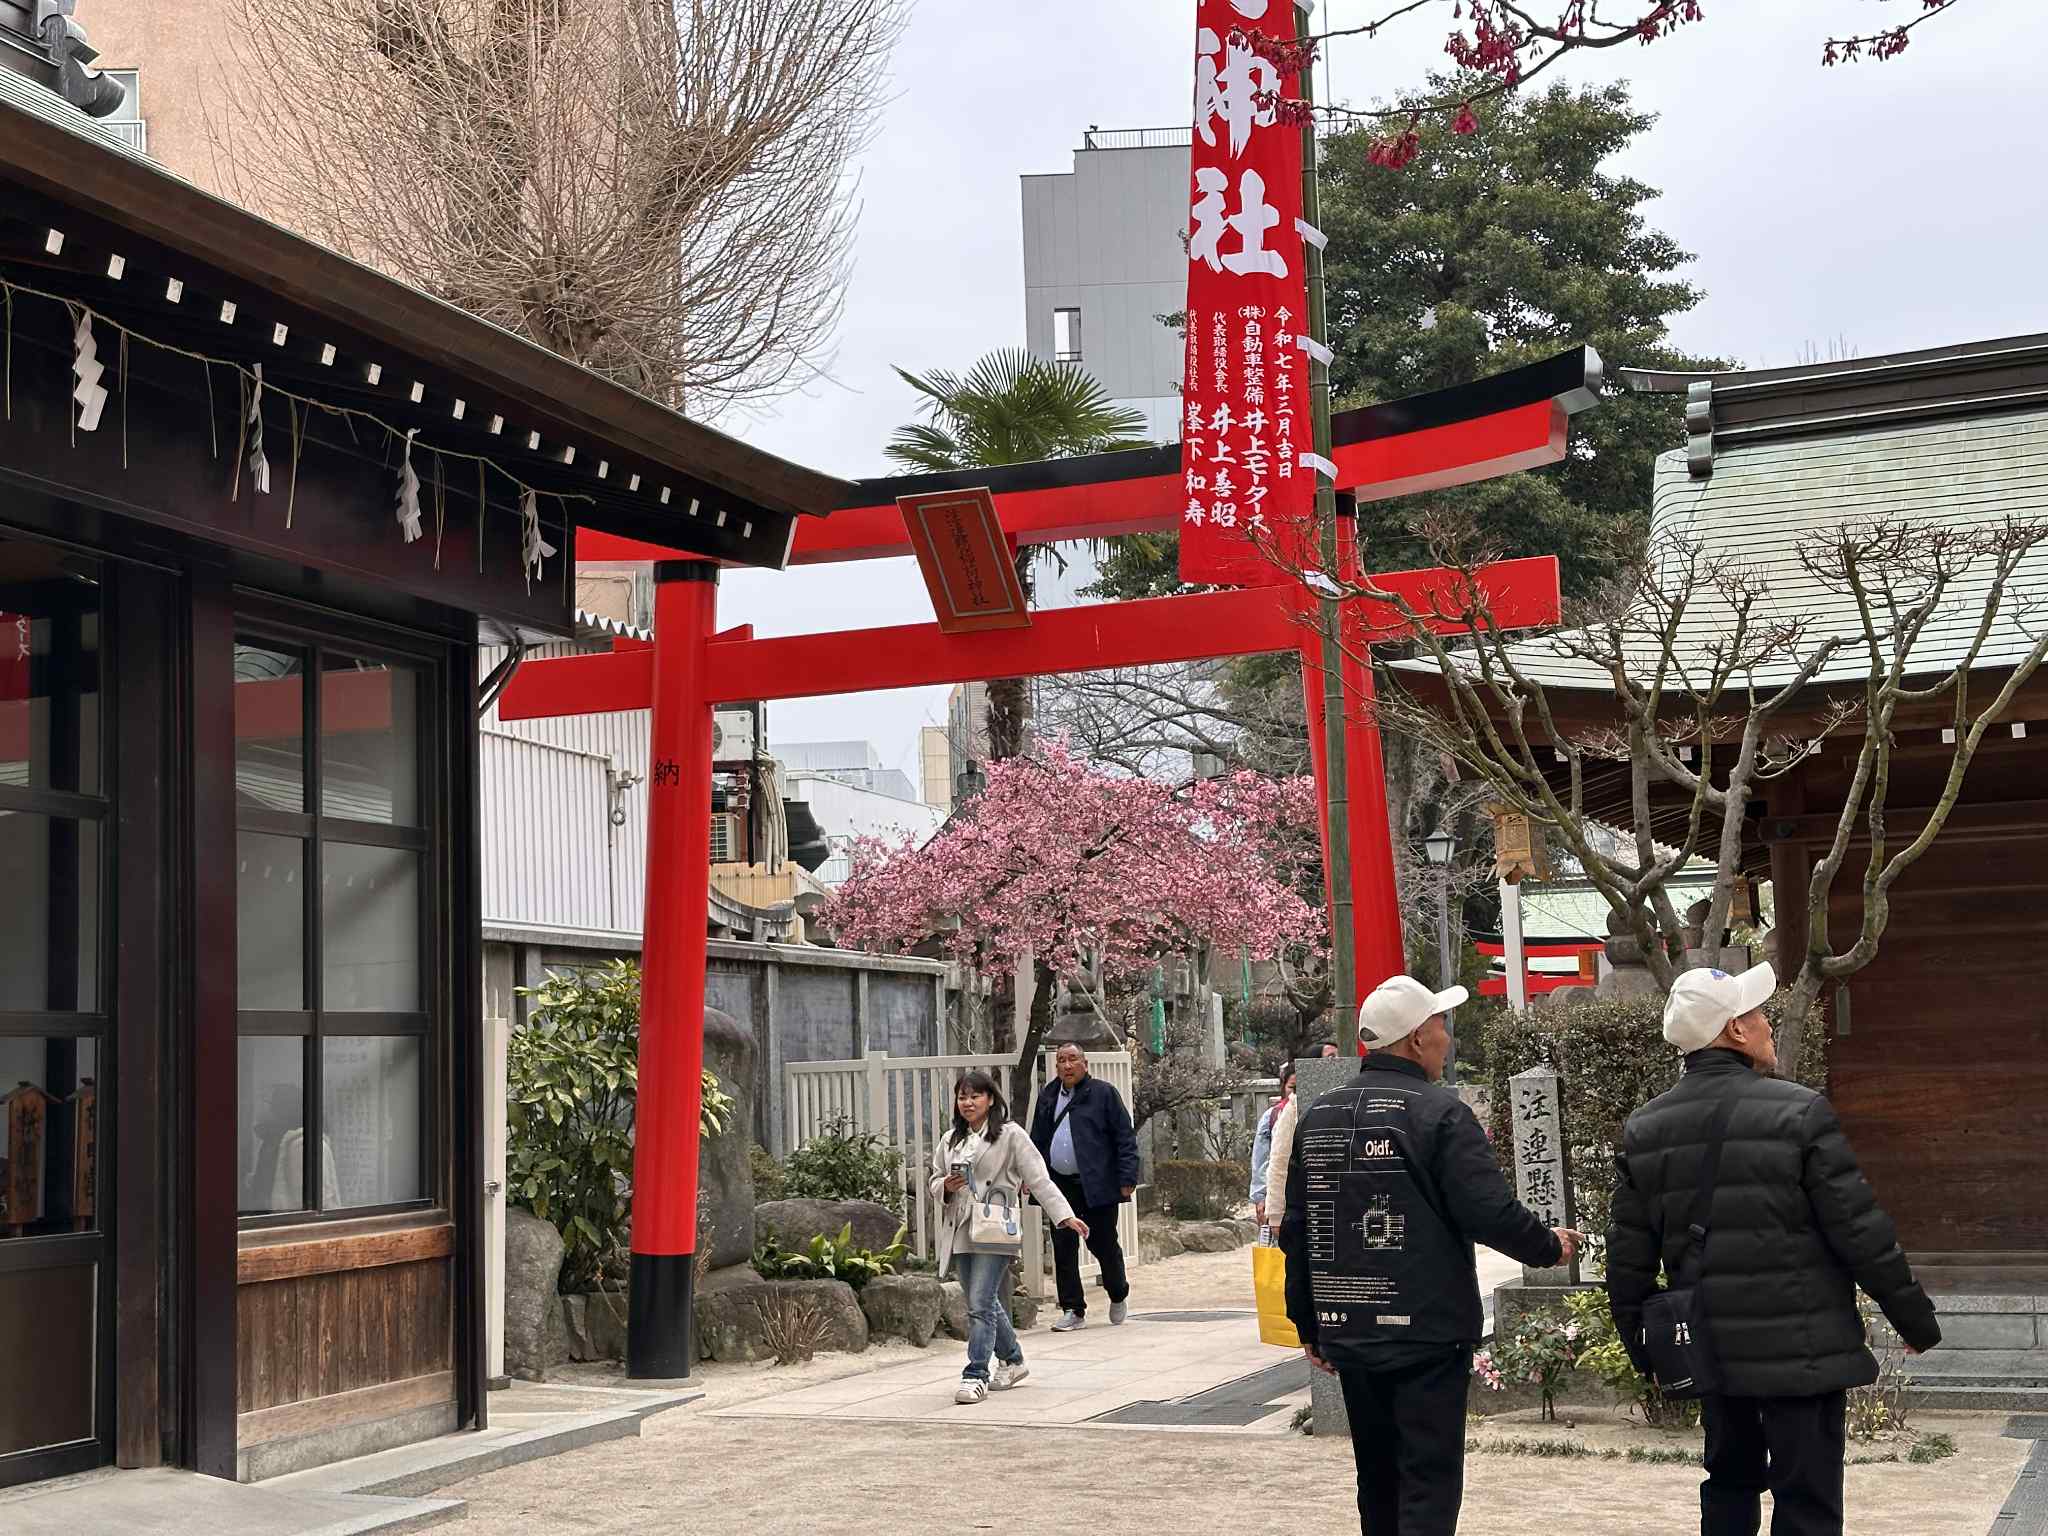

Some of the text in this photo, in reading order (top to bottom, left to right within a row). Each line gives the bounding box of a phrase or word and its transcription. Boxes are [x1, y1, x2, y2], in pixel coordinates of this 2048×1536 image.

[1191, 0, 1288, 279] 神社
[1207, 402, 1238, 529] 井上善昭
[1272, 305, 1295, 479] 令和七年三月吉日
[654, 758, 680, 787] 納
